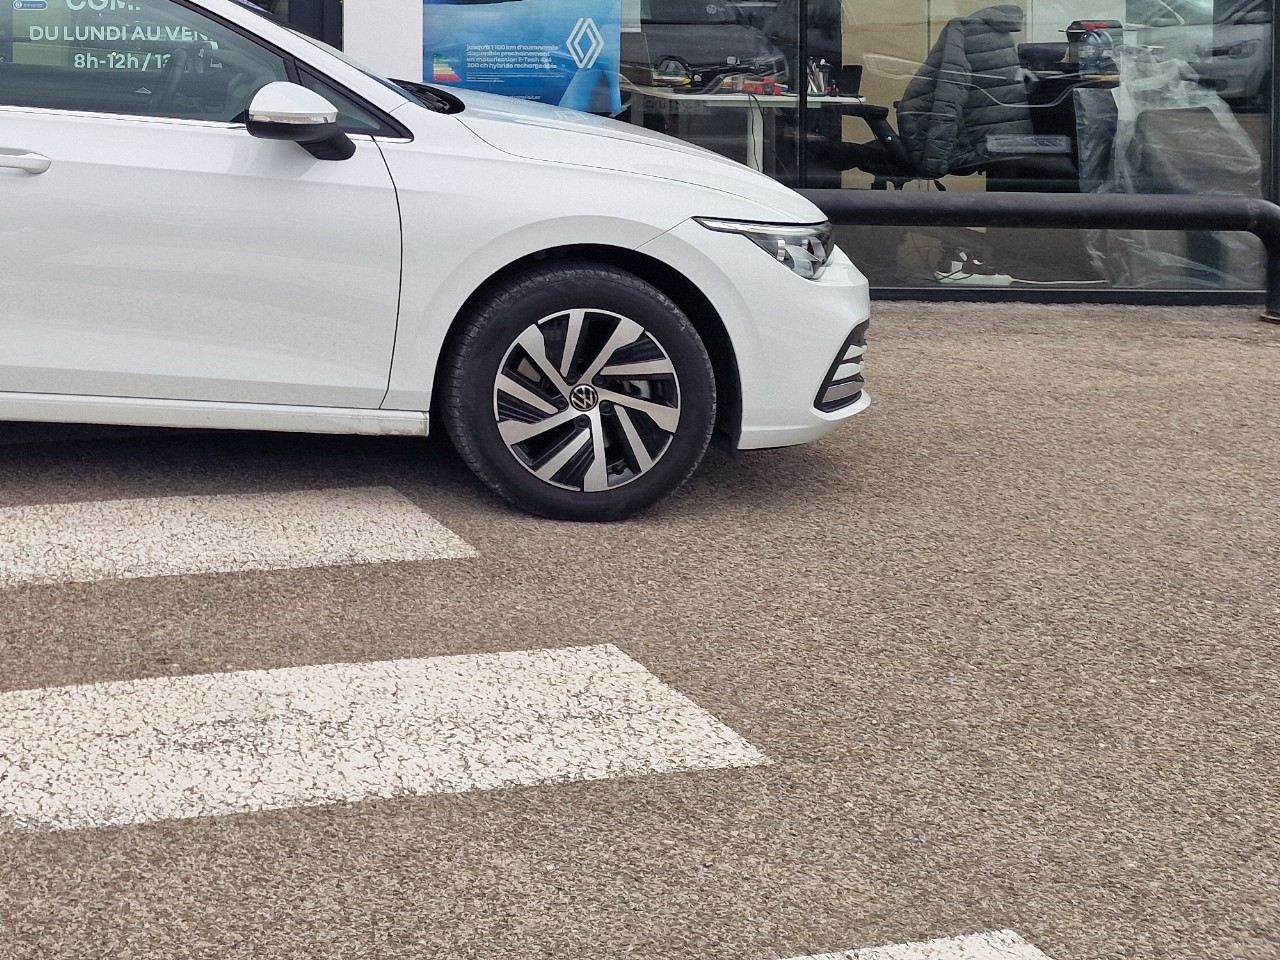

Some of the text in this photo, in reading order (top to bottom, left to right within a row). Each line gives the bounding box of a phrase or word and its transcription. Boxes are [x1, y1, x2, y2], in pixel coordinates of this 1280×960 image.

[29, 26, 59, 41] DU
[63, 26, 127, 41] LUNDI
[131, 26, 161, 41] AU
[73, 52, 139, 69] 8h-12h
